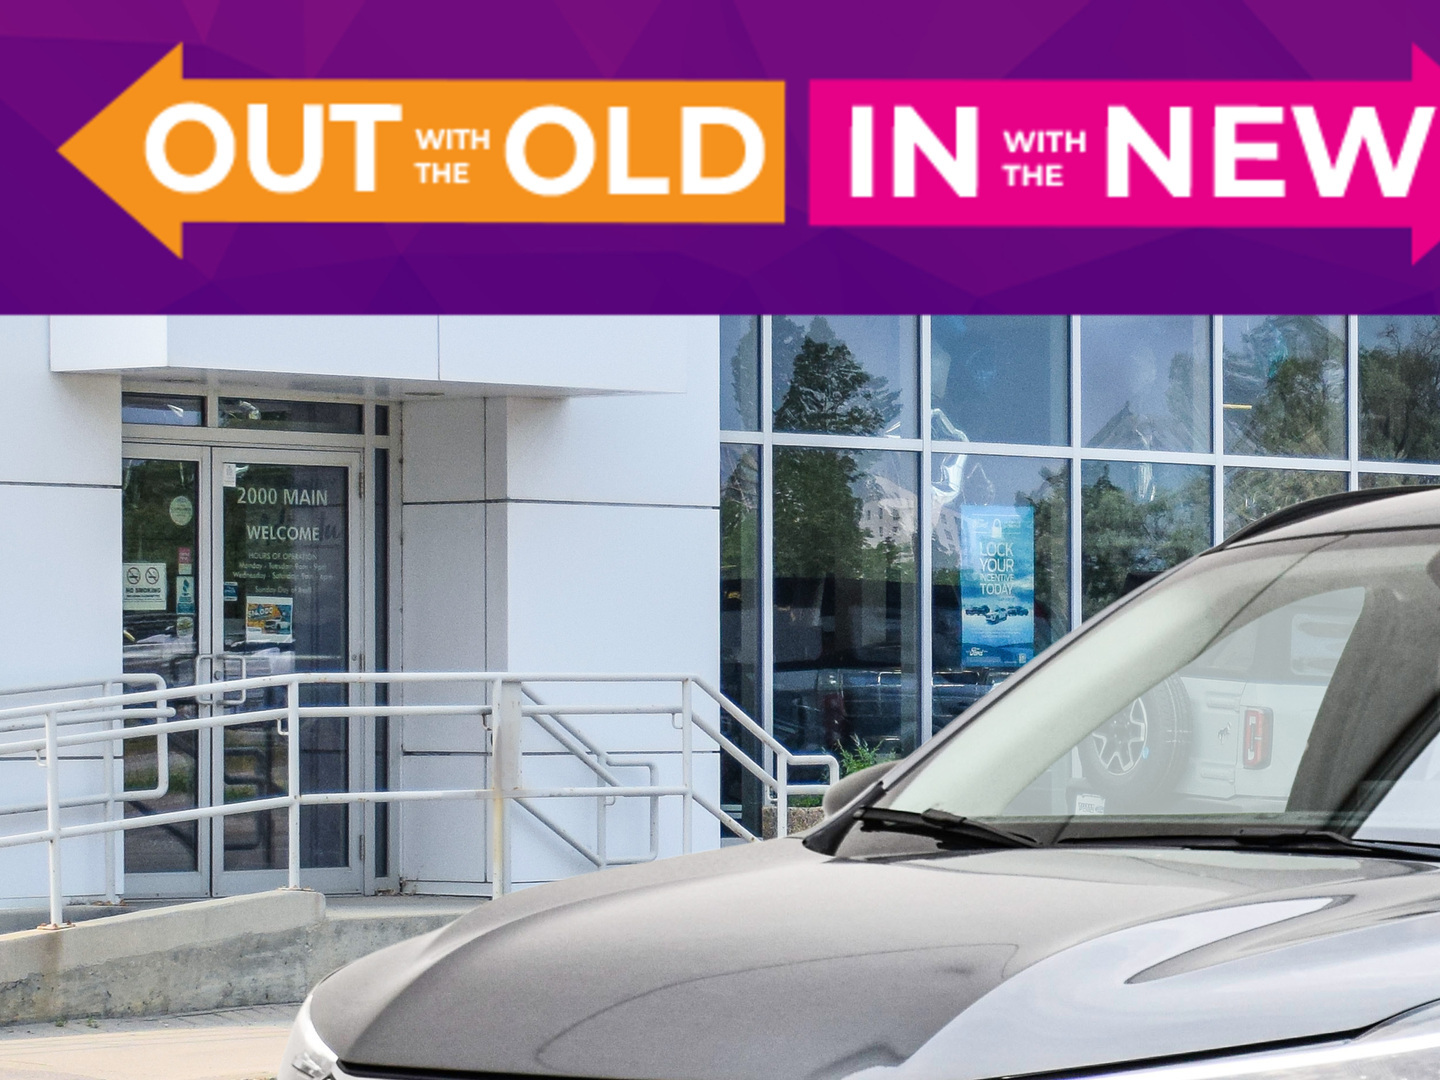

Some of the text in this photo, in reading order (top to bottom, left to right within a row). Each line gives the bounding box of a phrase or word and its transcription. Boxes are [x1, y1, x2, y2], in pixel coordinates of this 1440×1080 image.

[237, 487, 328, 506] 2000 MAIN
[246, 525, 320, 541] WELCOME
[980, 541, 1014, 557] LOCK
[980, 558, 1015, 572] YOUR
[980, 583, 1014, 595] TODAY
